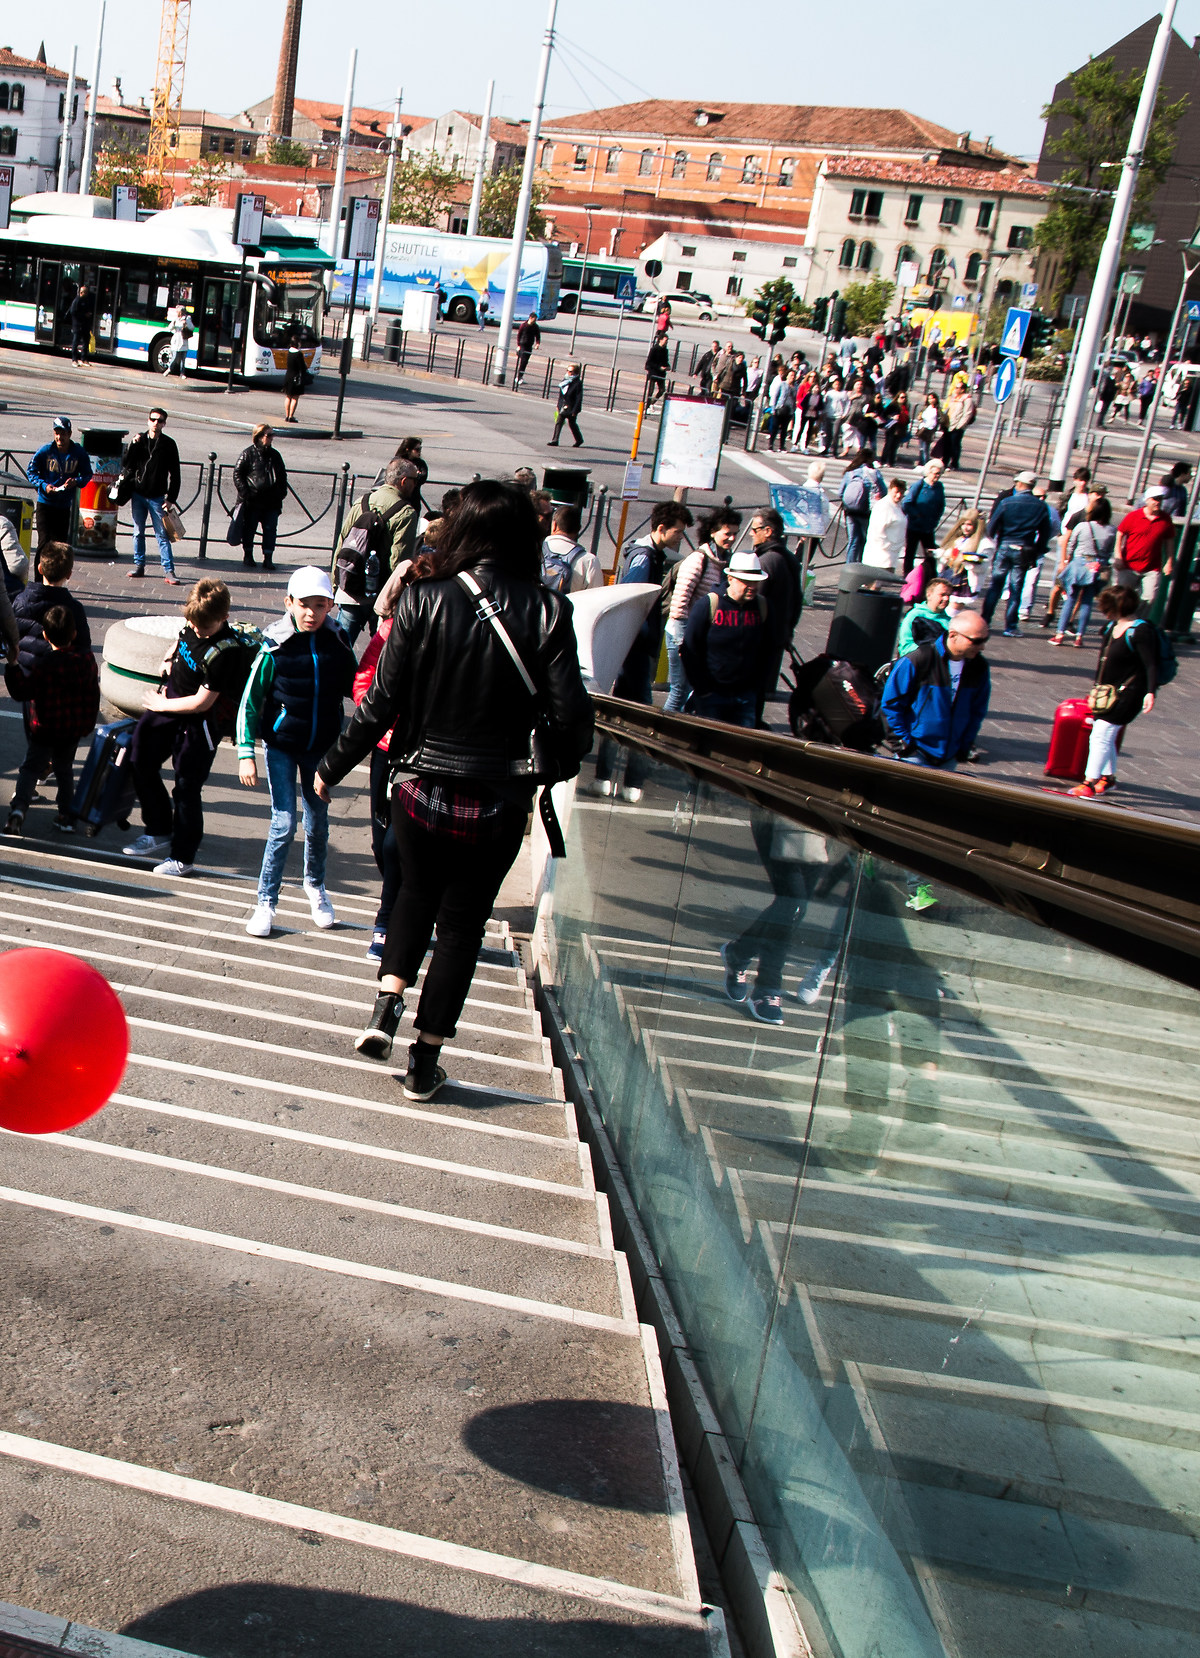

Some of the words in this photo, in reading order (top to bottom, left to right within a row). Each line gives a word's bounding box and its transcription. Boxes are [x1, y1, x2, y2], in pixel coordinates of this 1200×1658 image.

[0, 173, 9, 182] A4
[368, 205, 378, 215] A5
[390, 241, 439, 258] SHUTTLE
